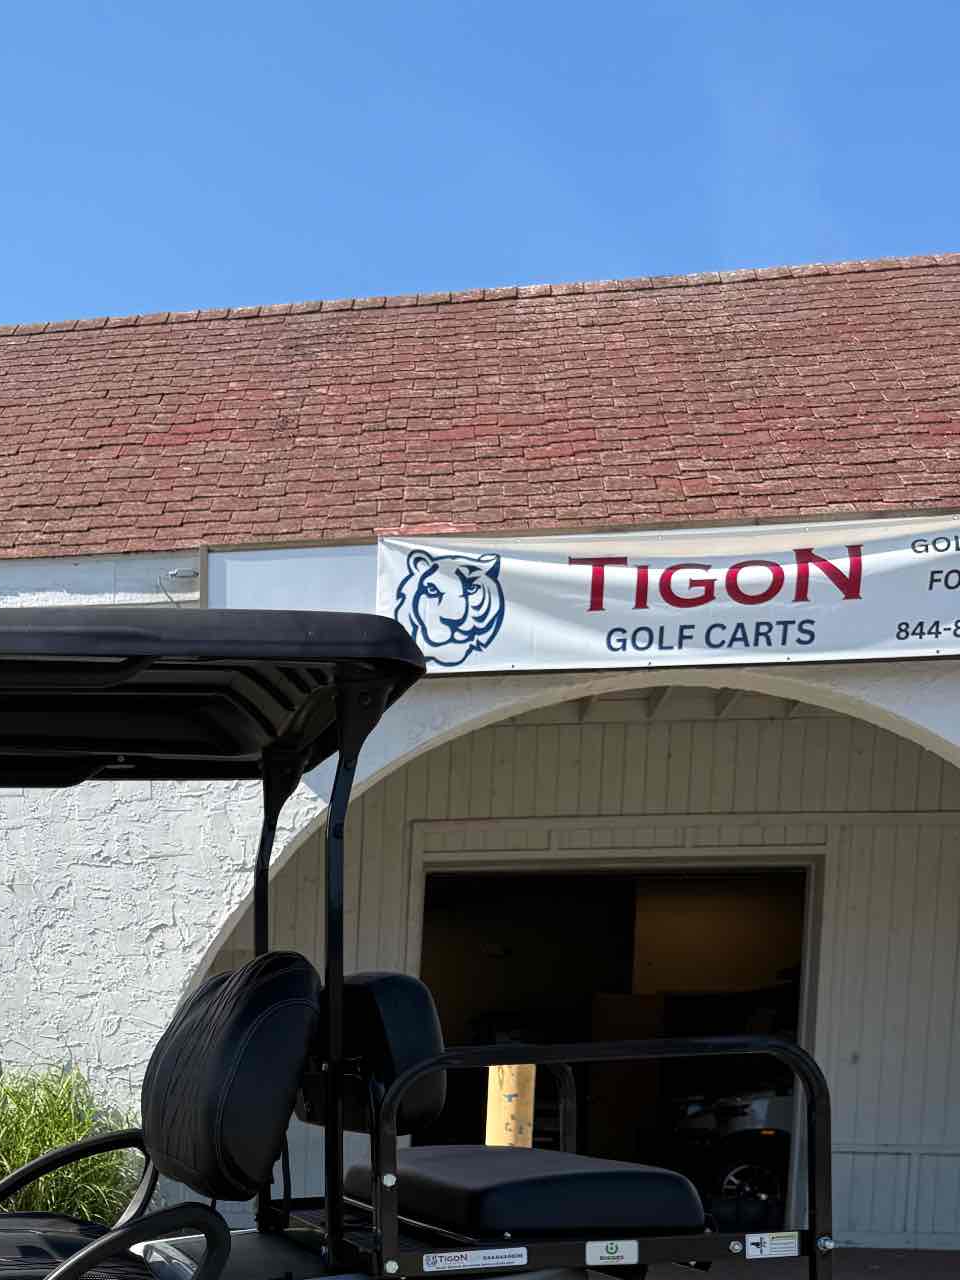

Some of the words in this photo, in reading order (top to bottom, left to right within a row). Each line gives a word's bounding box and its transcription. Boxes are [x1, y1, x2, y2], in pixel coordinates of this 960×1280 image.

[568, 544, 864, 613] TIGON
[606, 623, 696, 652] GOLF
[704, 618, 816, 649] CARTS
